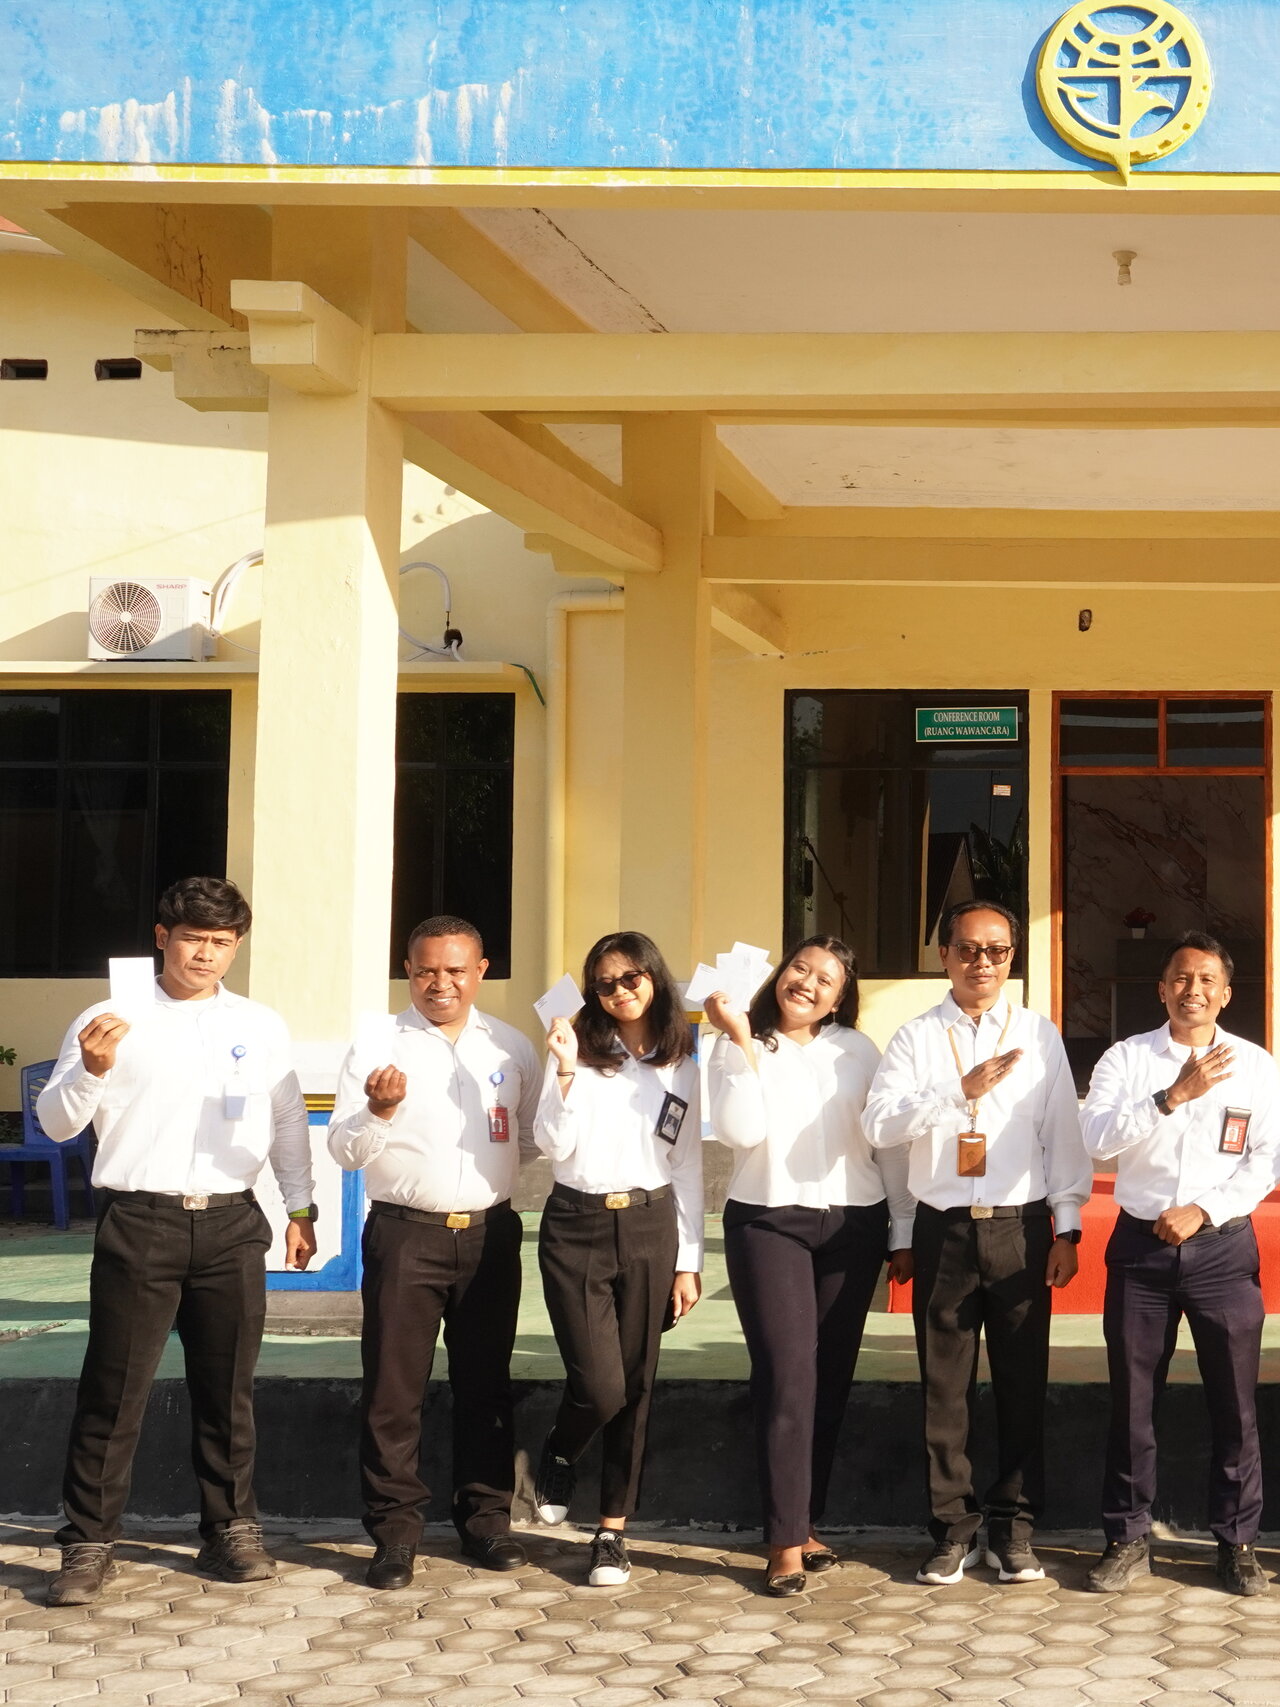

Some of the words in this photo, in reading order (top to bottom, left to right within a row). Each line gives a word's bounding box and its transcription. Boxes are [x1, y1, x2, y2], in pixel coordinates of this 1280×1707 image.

[933, 712, 978, 722] CONFERENCE
[979, 711, 1000, 721] ROOM
[924, 727, 954, 737] (RUANG
[955, 726, 1010, 736] WAWANCARA)
